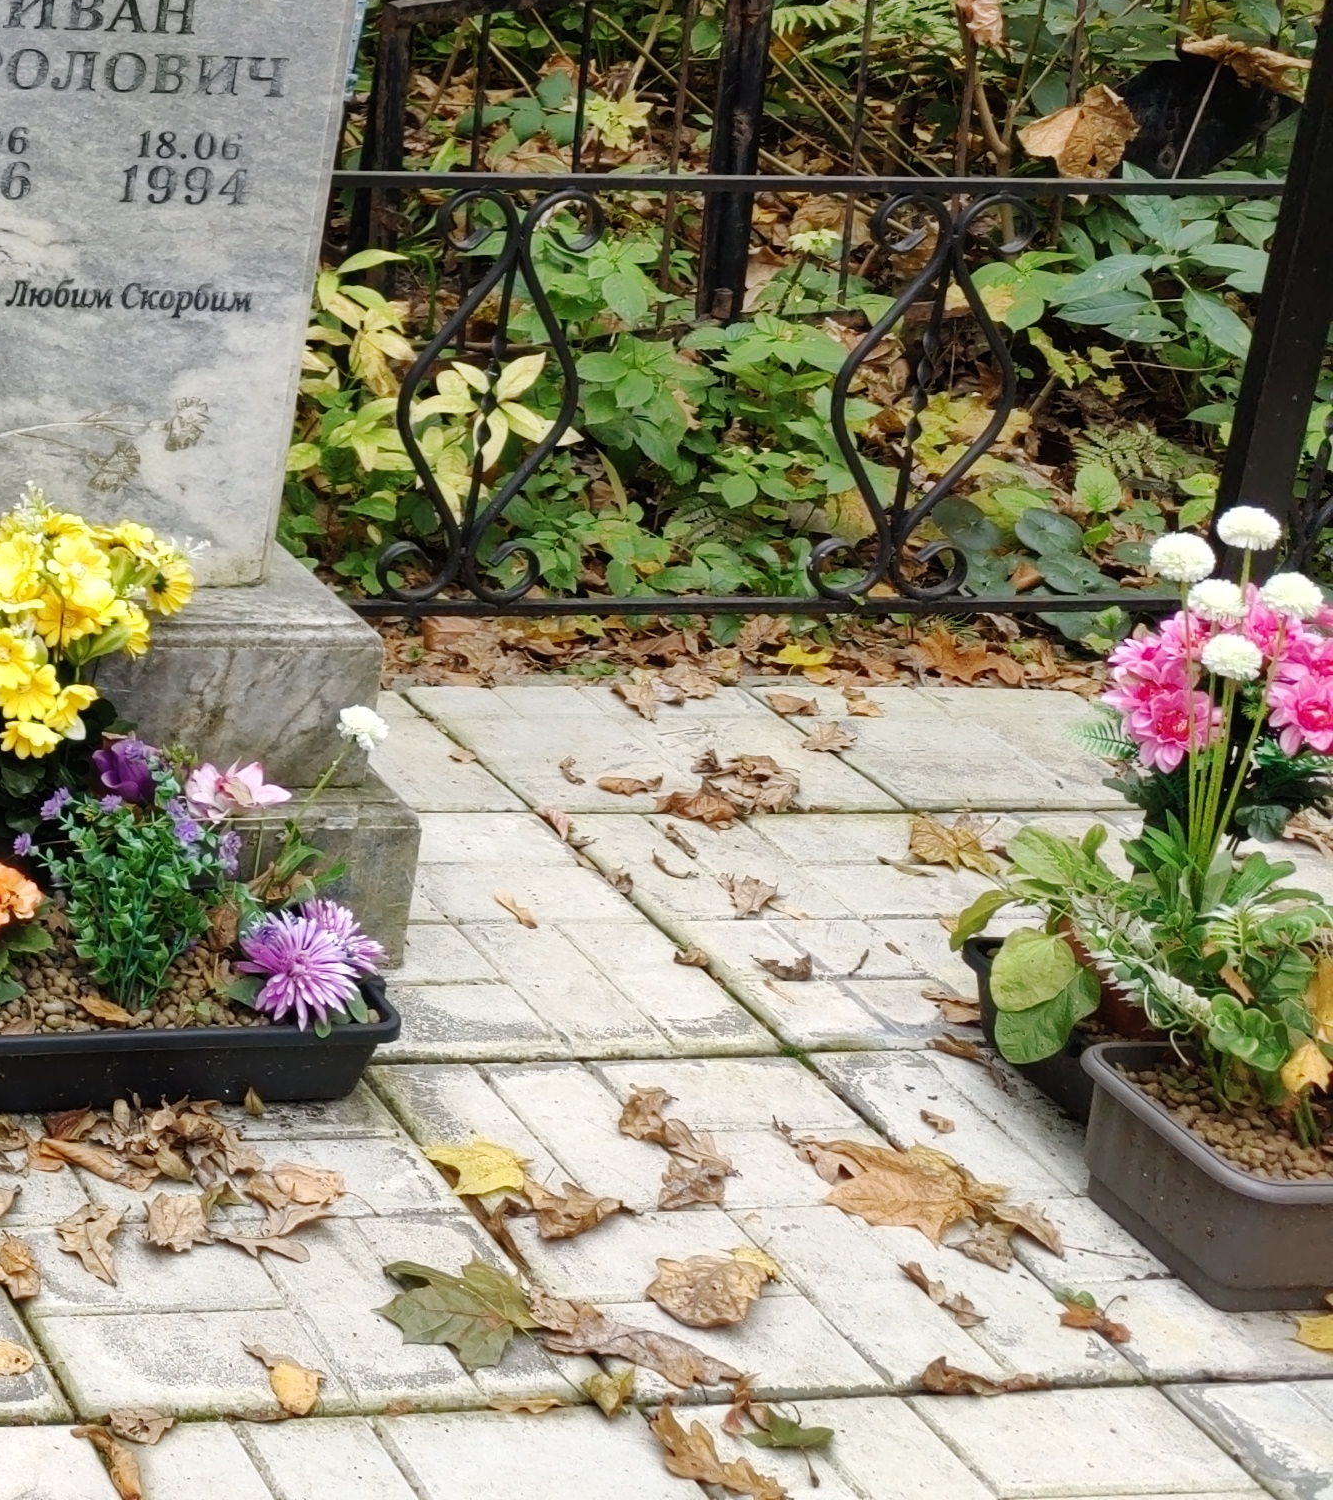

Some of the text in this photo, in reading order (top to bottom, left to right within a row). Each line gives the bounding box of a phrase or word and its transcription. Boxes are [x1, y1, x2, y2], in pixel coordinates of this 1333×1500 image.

[137, 130, 244, 161] 18.06
[119, 164, 250, 206] 1994
[5, 279, 113, 309] Любим
[121, 281, 252, 319] Скорбим
